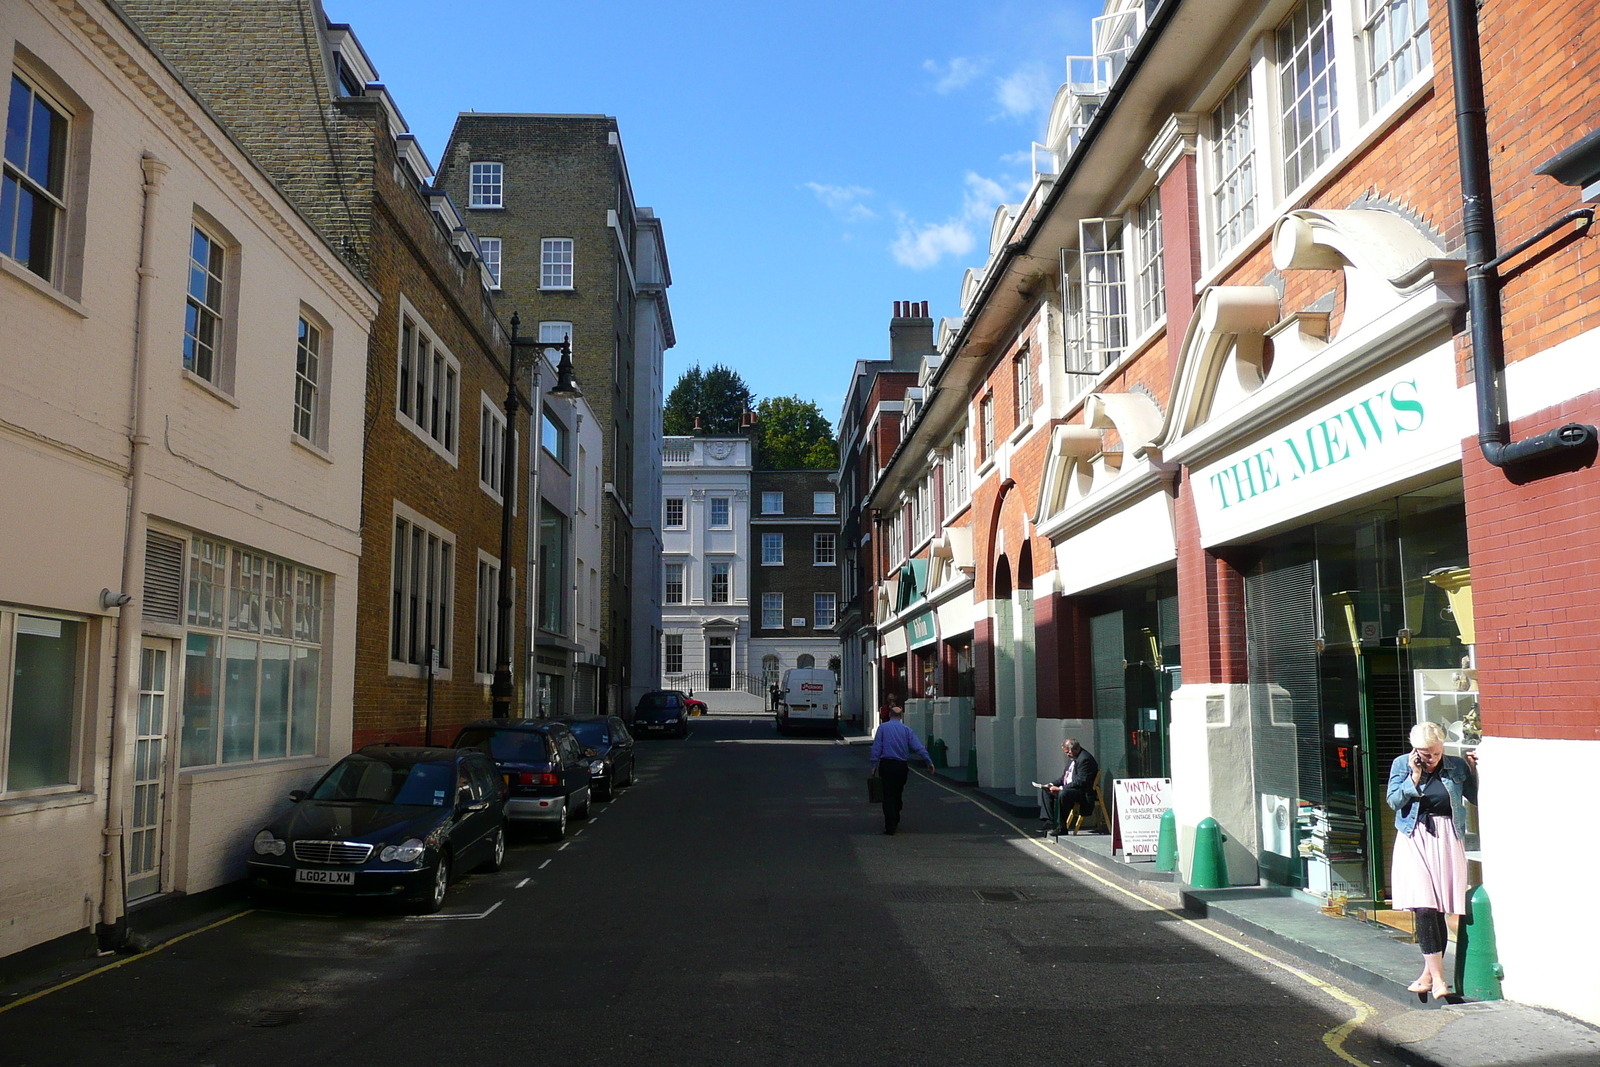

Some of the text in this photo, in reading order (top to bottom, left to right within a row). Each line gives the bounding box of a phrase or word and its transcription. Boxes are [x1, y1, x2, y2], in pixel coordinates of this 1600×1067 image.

[1210, 377, 1425, 511] THE MEWS
[1133, 844, 1150, 853] NOW
[299, 871, 351, 883] LG02 LXM
